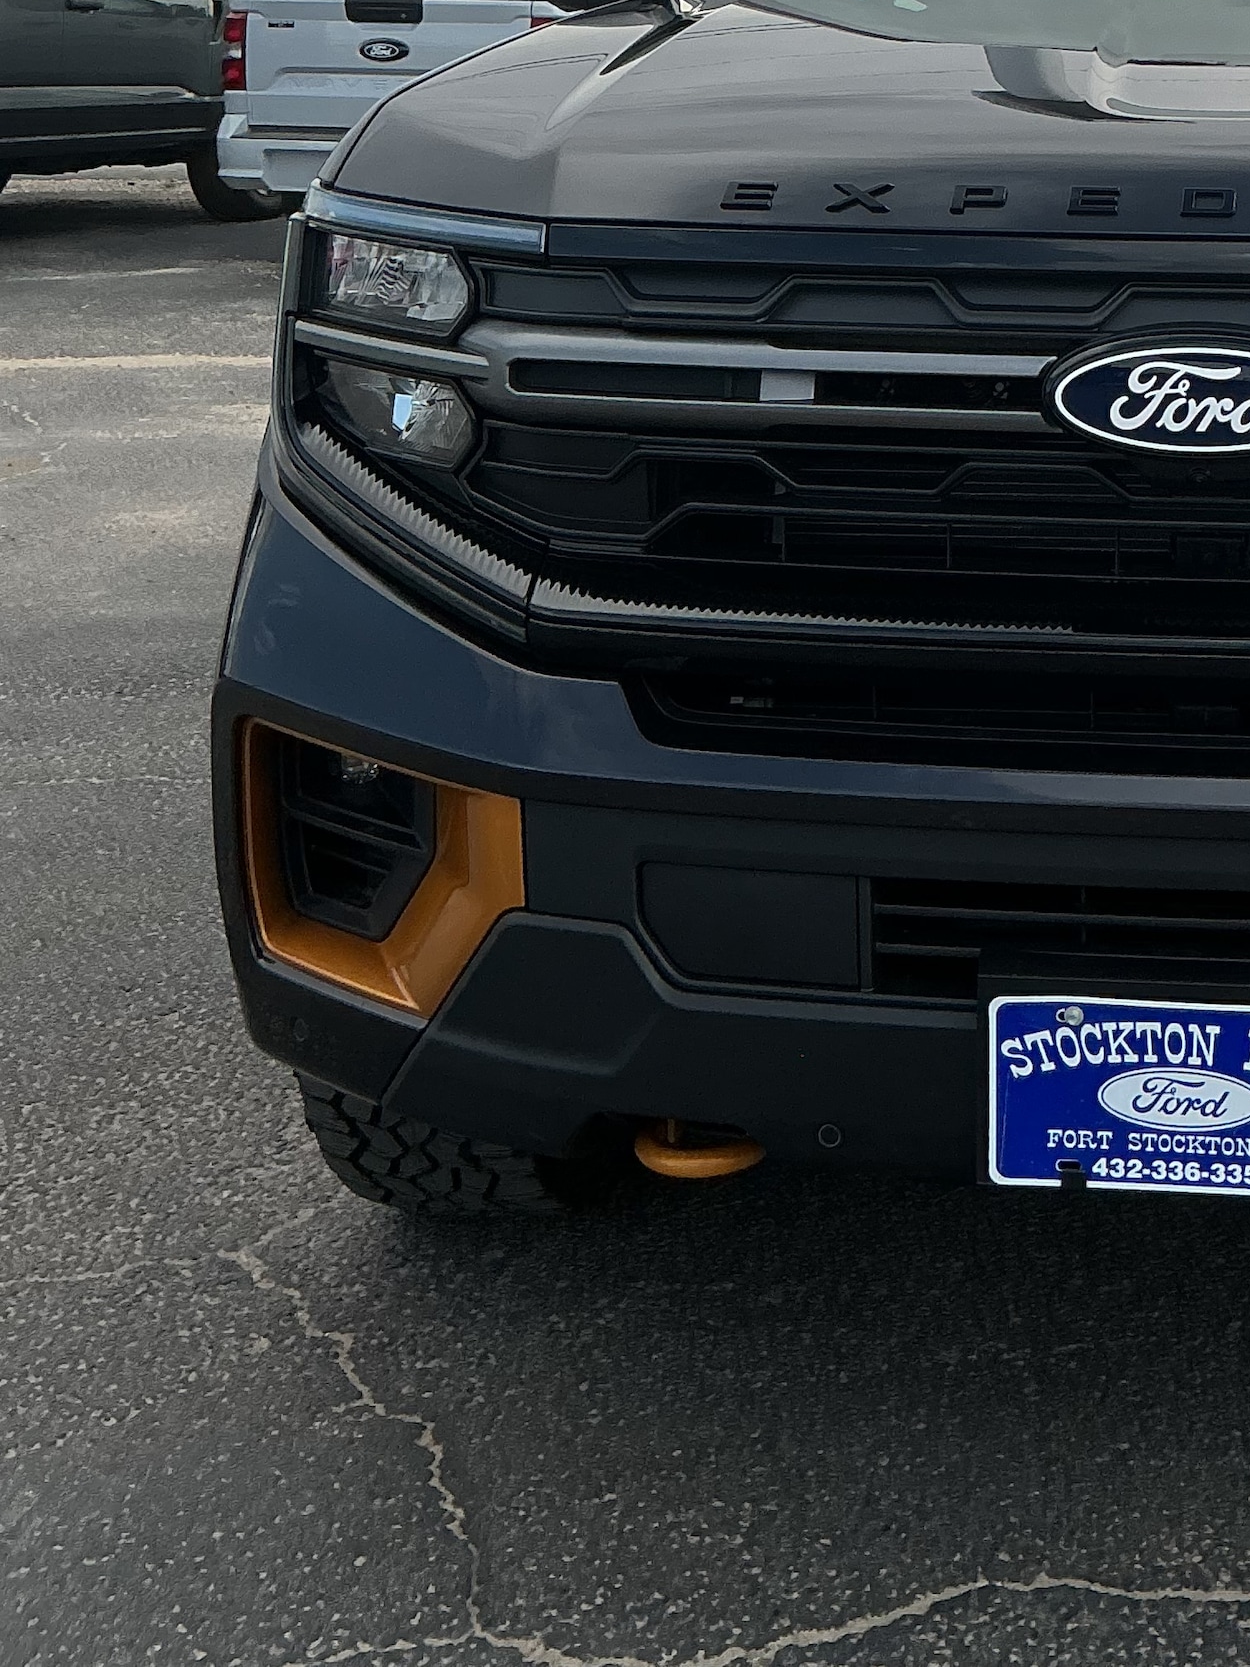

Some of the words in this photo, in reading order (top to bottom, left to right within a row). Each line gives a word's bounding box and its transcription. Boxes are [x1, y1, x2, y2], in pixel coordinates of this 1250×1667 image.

[1000, 1021, 1221, 1079] STOCKTON
[1132, 1078, 1229, 1117] Ford
[1047, 1129, 1113, 1151] FORT
